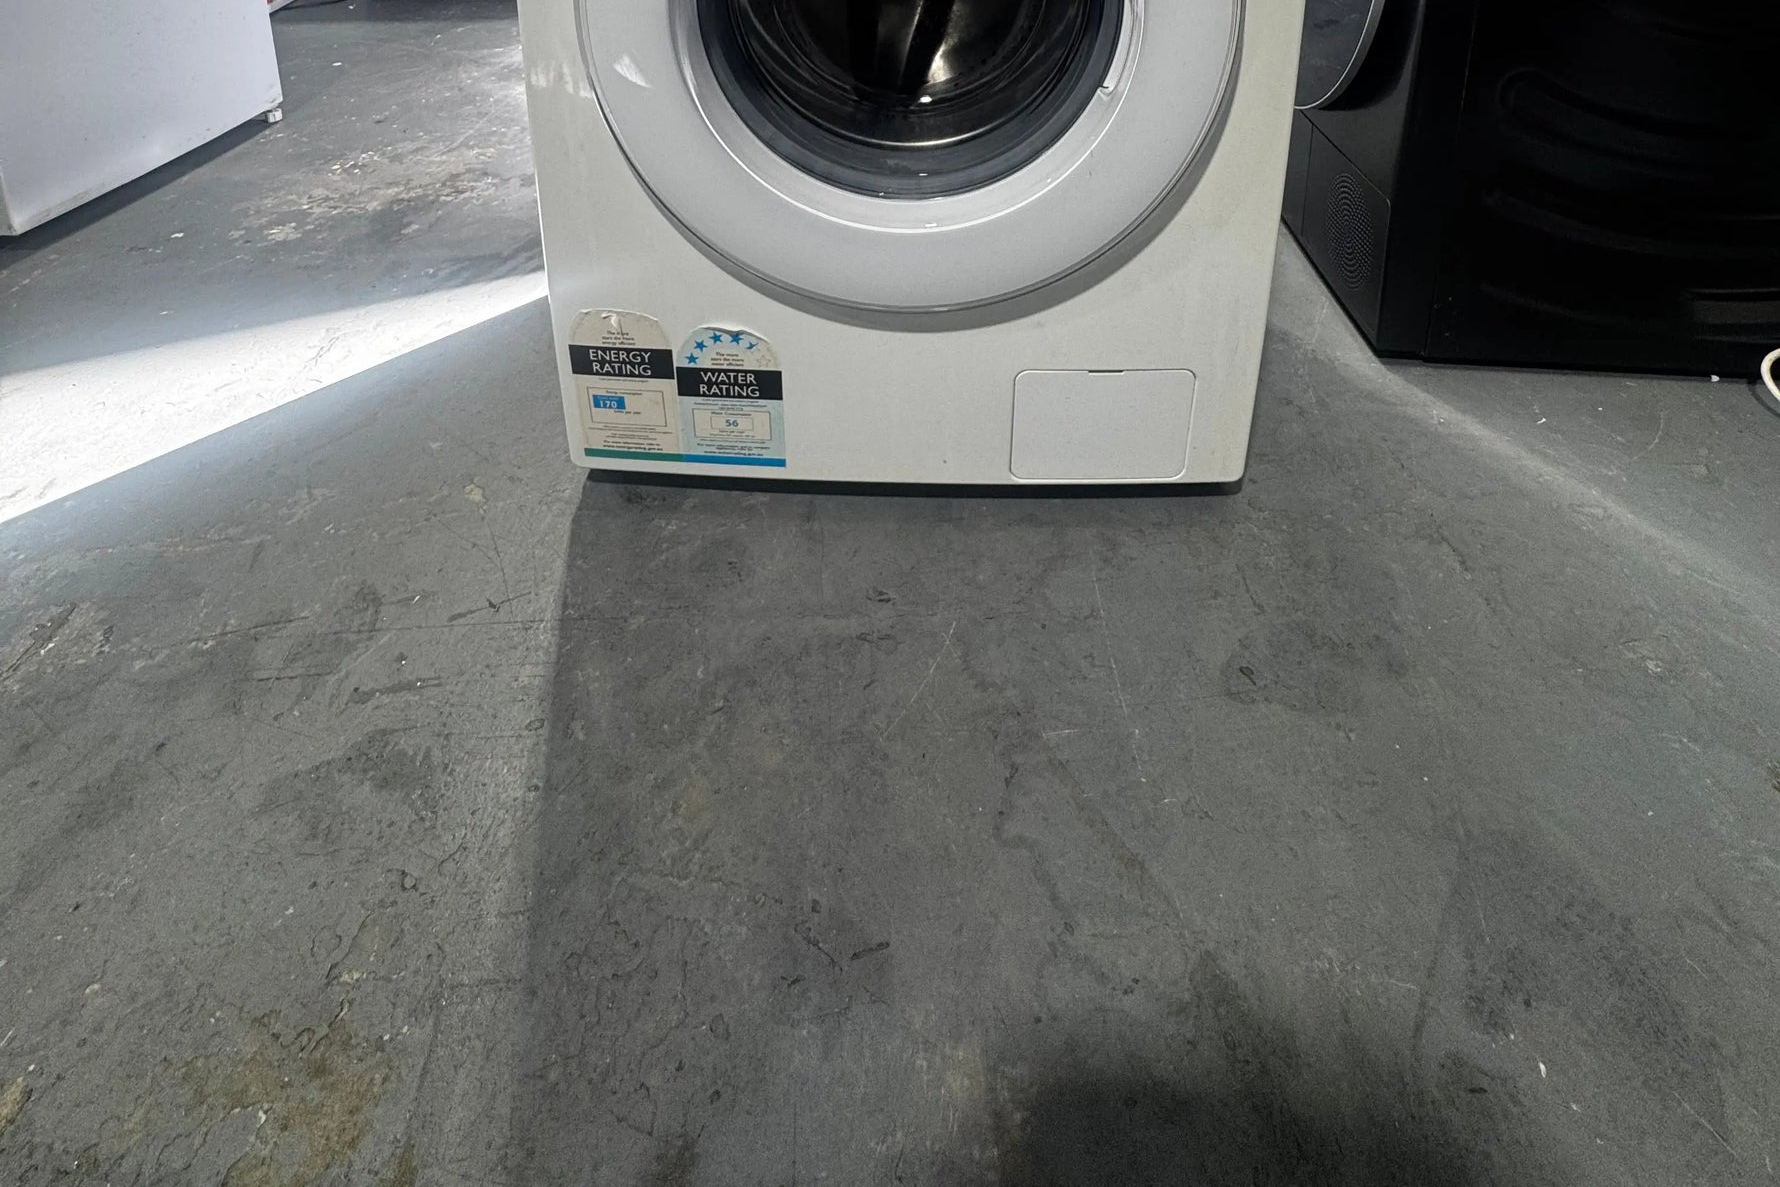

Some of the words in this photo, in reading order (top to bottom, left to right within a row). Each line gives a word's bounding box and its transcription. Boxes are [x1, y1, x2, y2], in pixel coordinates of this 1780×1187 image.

[589, 349, 651, 363] ENERGY
[592, 362, 652, 376] RATING
[700, 371, 758, 385] WATER
[699, 384, 760, 397] RATING
[599, 400, 617, 409] 170
[724, 419, 739, 427] 56
